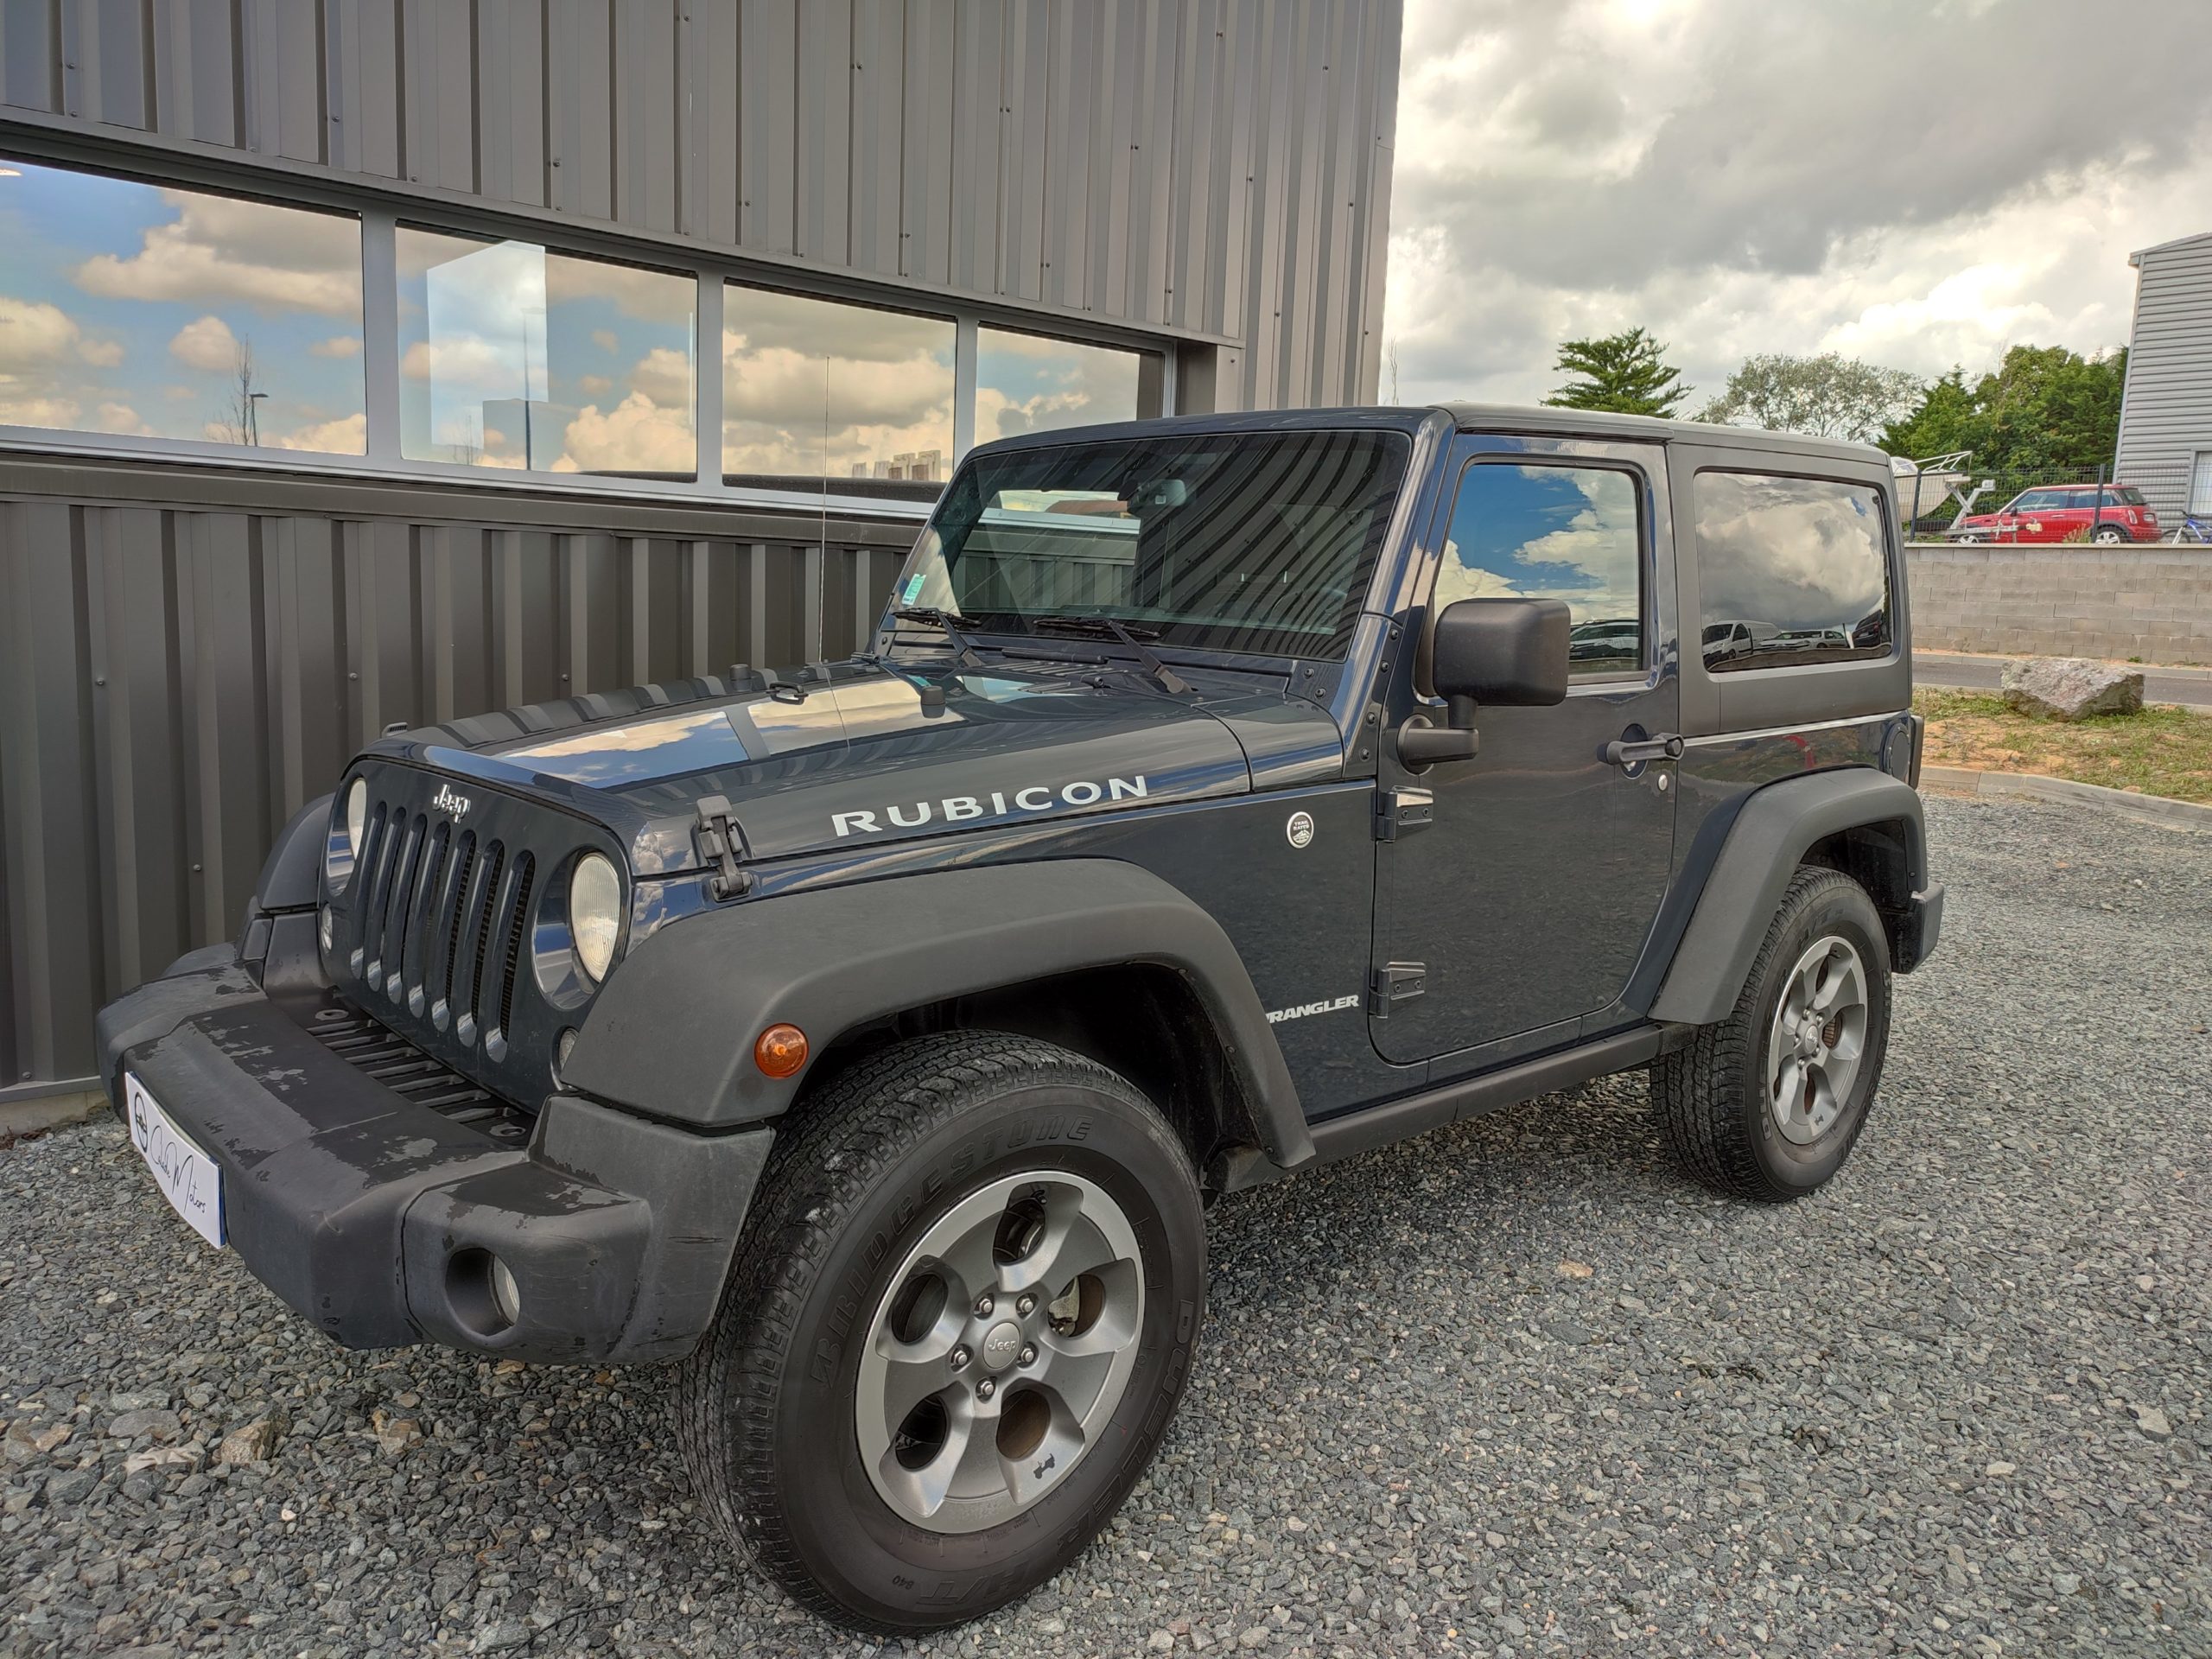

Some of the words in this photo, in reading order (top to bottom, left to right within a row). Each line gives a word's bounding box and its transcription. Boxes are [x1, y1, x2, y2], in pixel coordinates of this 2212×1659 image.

[433, 784, 471, 824] Jeep
[831, 775, 1148, 836] RUBICON
[1265, 995, 1359, 1023] RANGLER
[810, 1114, 1095, 1390] BRIDGESTONE
[988, 1338, 1016, 1353] Jeep
[1057, 1299, 1195, 1556] DUELER
[892, 1574, 915, 1591] 840
